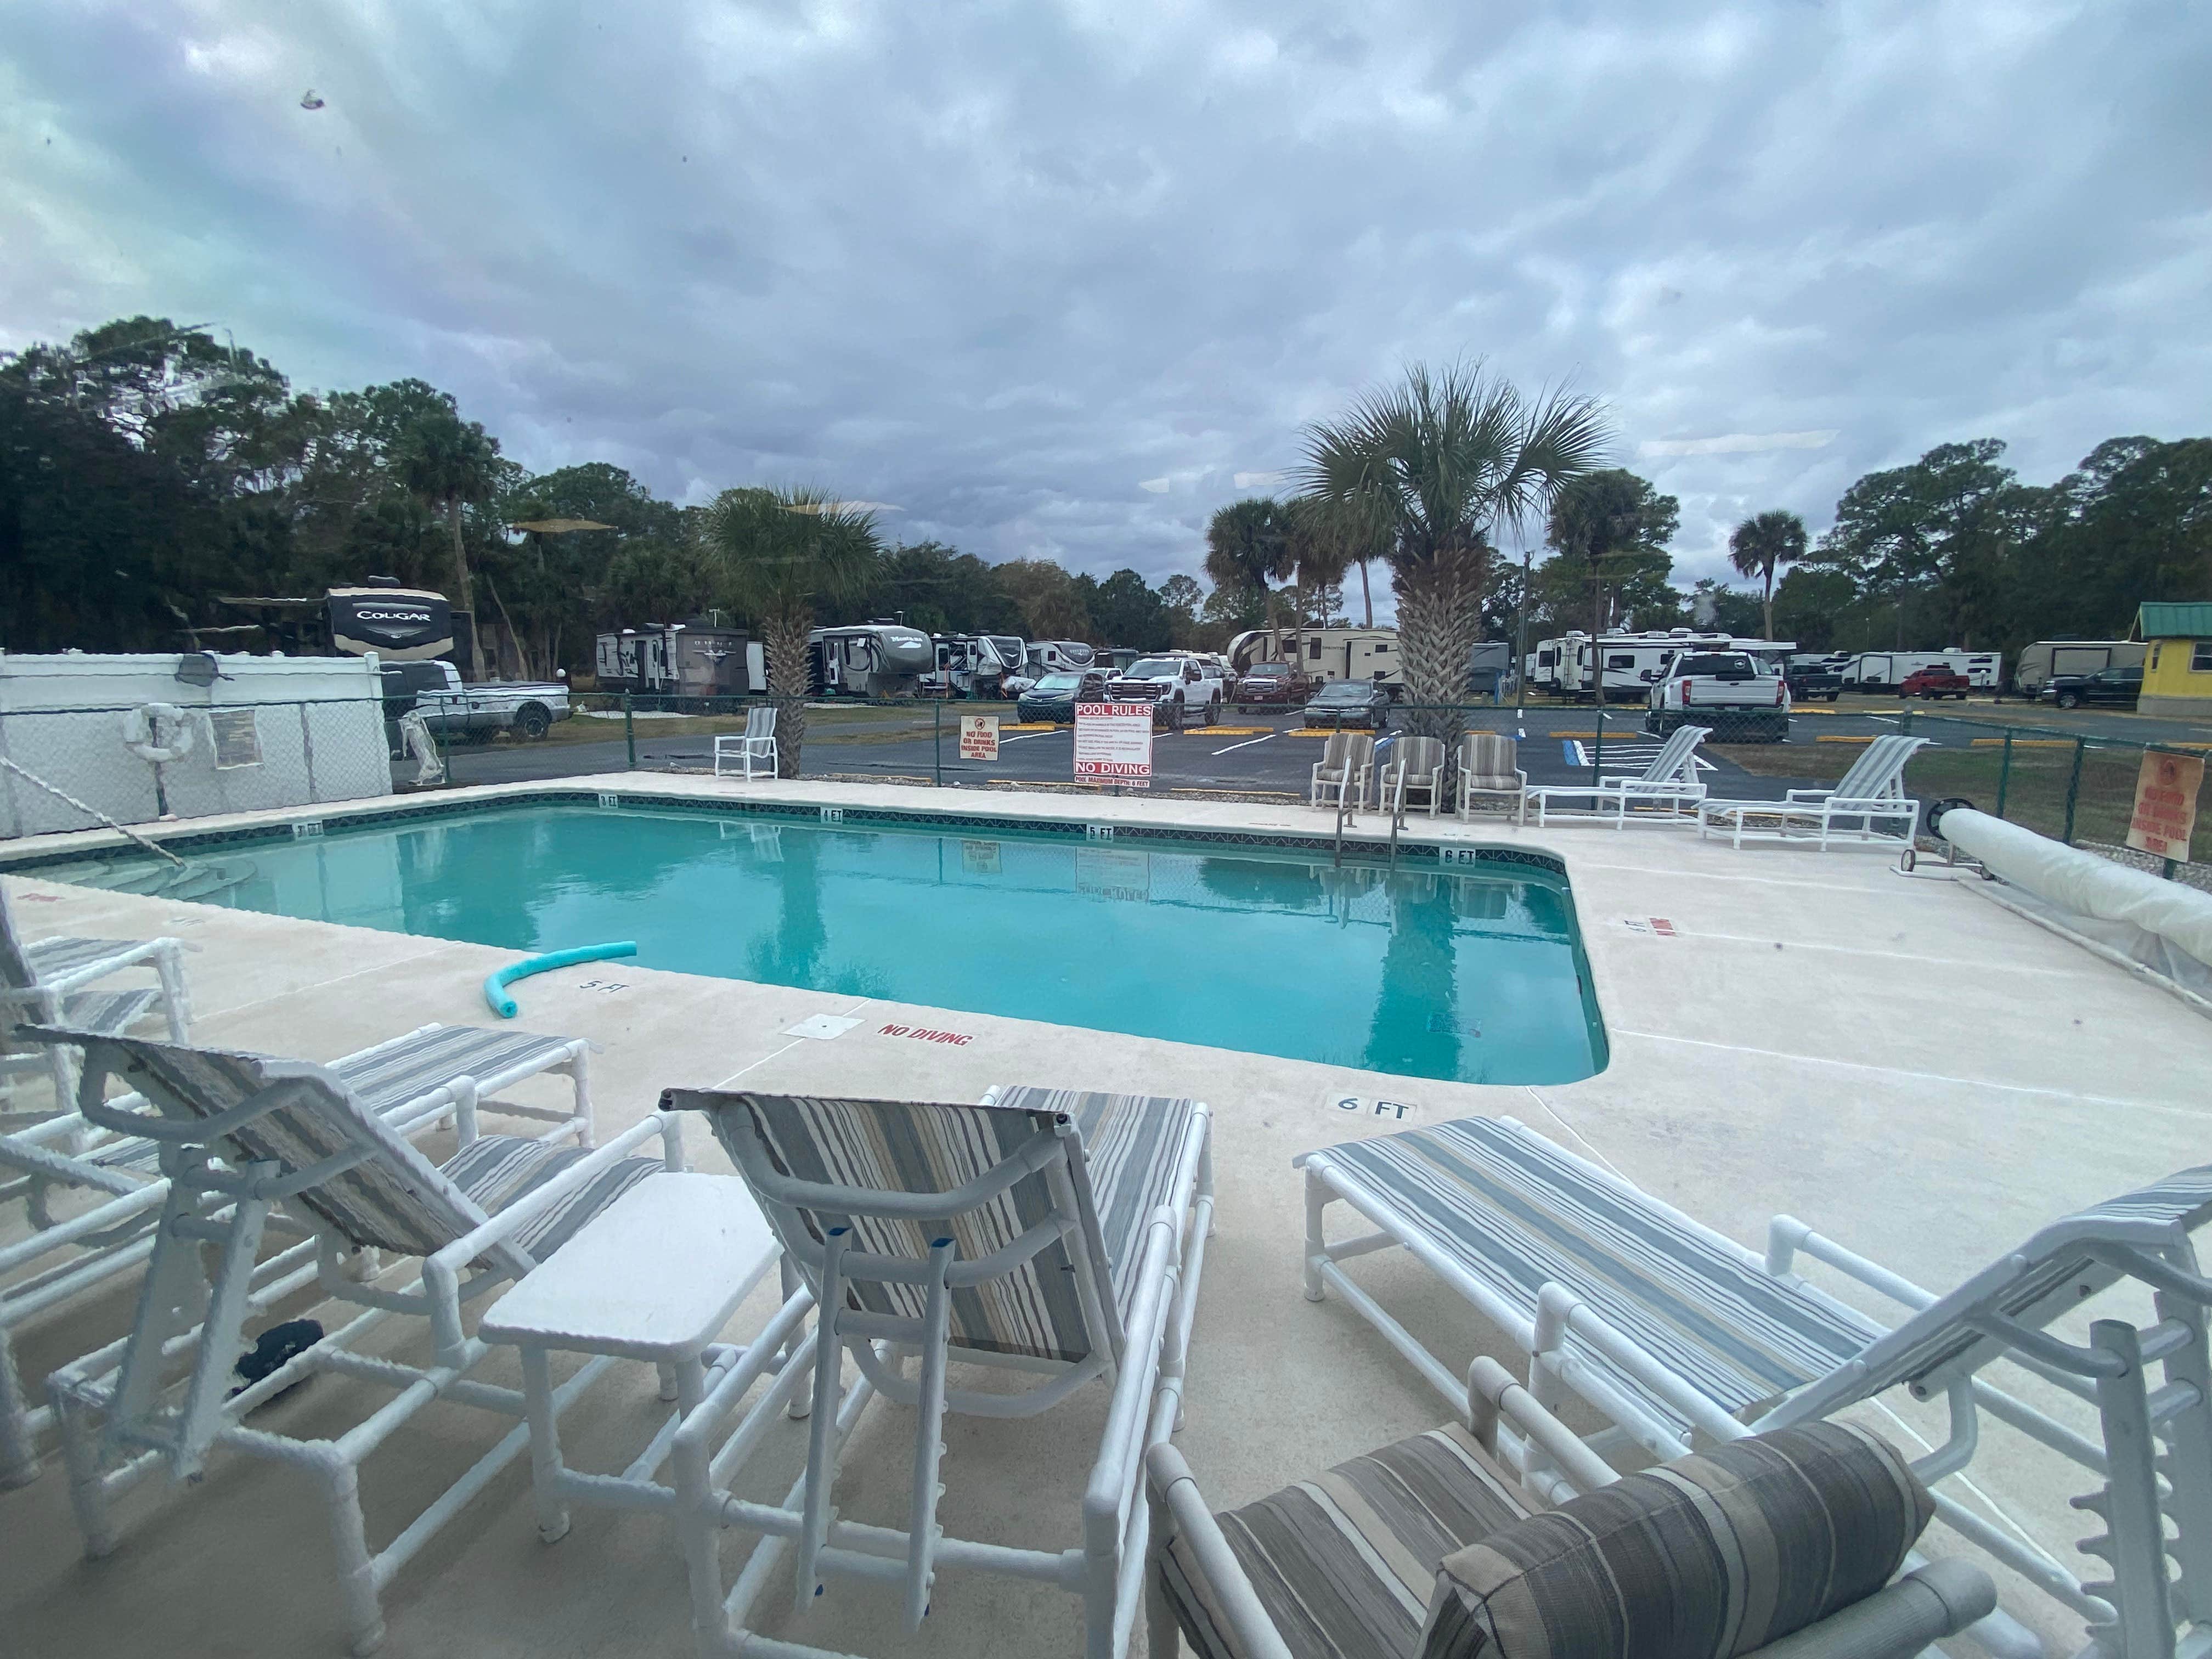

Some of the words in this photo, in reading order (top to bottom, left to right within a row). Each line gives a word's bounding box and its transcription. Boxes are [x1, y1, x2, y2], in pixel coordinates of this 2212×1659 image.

[357, 611, 431, 622] COUGAR
[1076, 704, 1109, 715] POOL
[1111, 705, 1151, 716] RULES
[1076, 762, 1096, 772] NO
[1101, 763, 1150, 775] DIVING
[877, 1024, 910, 1036] NO
[906, 1028, 973, 1046] DIVING
[1338, 1097, 1358, 1110] 6
[1374, 1101, 1409, 1119] FT
